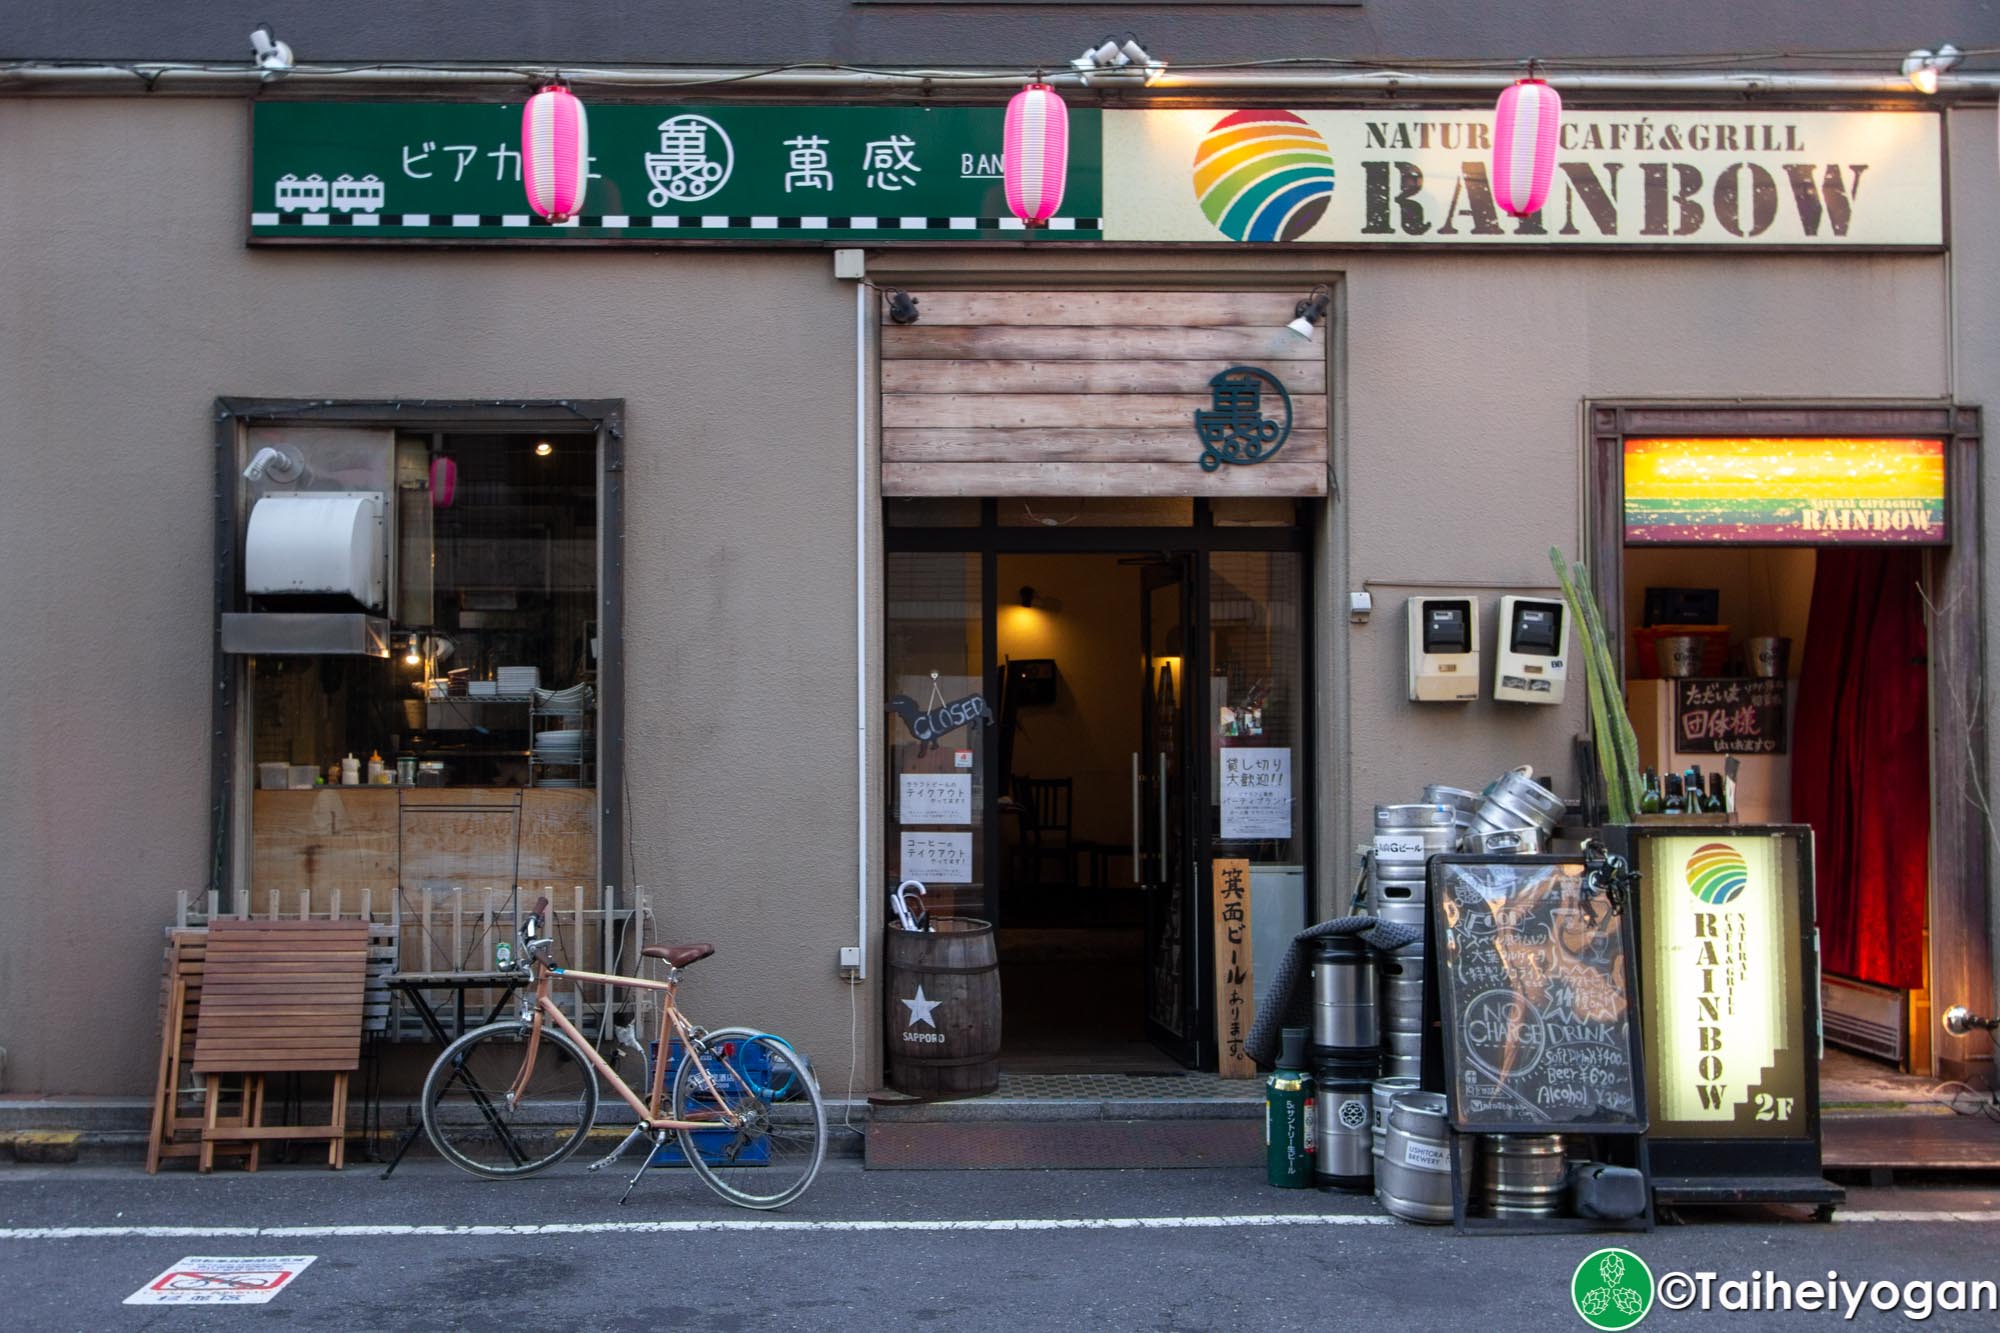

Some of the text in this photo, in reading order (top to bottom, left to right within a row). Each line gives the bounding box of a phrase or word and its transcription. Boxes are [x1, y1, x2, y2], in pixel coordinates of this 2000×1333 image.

[1802, 508, 1933, 531] RAINBOW
[914, 696, 985, 739] CLOSED
[1682, 705, 1761, 740] 団体様
[906, 789, 965, 798] テイクアウト
[907, 849, 965, 858] テイクアウト
[1484, 1002, 1522, 1022] NO
[1694, 913, 1727, 1110] RAINBOW
[903, 1032, 945, 1043] SAPPORO
[1469, 1021, 1543, 1042] CHARGE
[1547, 1023, 1616, 1045] DRINK
[1544, 1048, 1568, 1066] Soft
[1547, 1067, 1579, 1084] Beer
[1537, 1083, 1588, 1105] Alcohol
[1754, 1093, 1794, 1121] 2F
[1408, 1153, 1441, 1165] BREWERY
[1409, 1146, 1444, 1158] USHITORA
